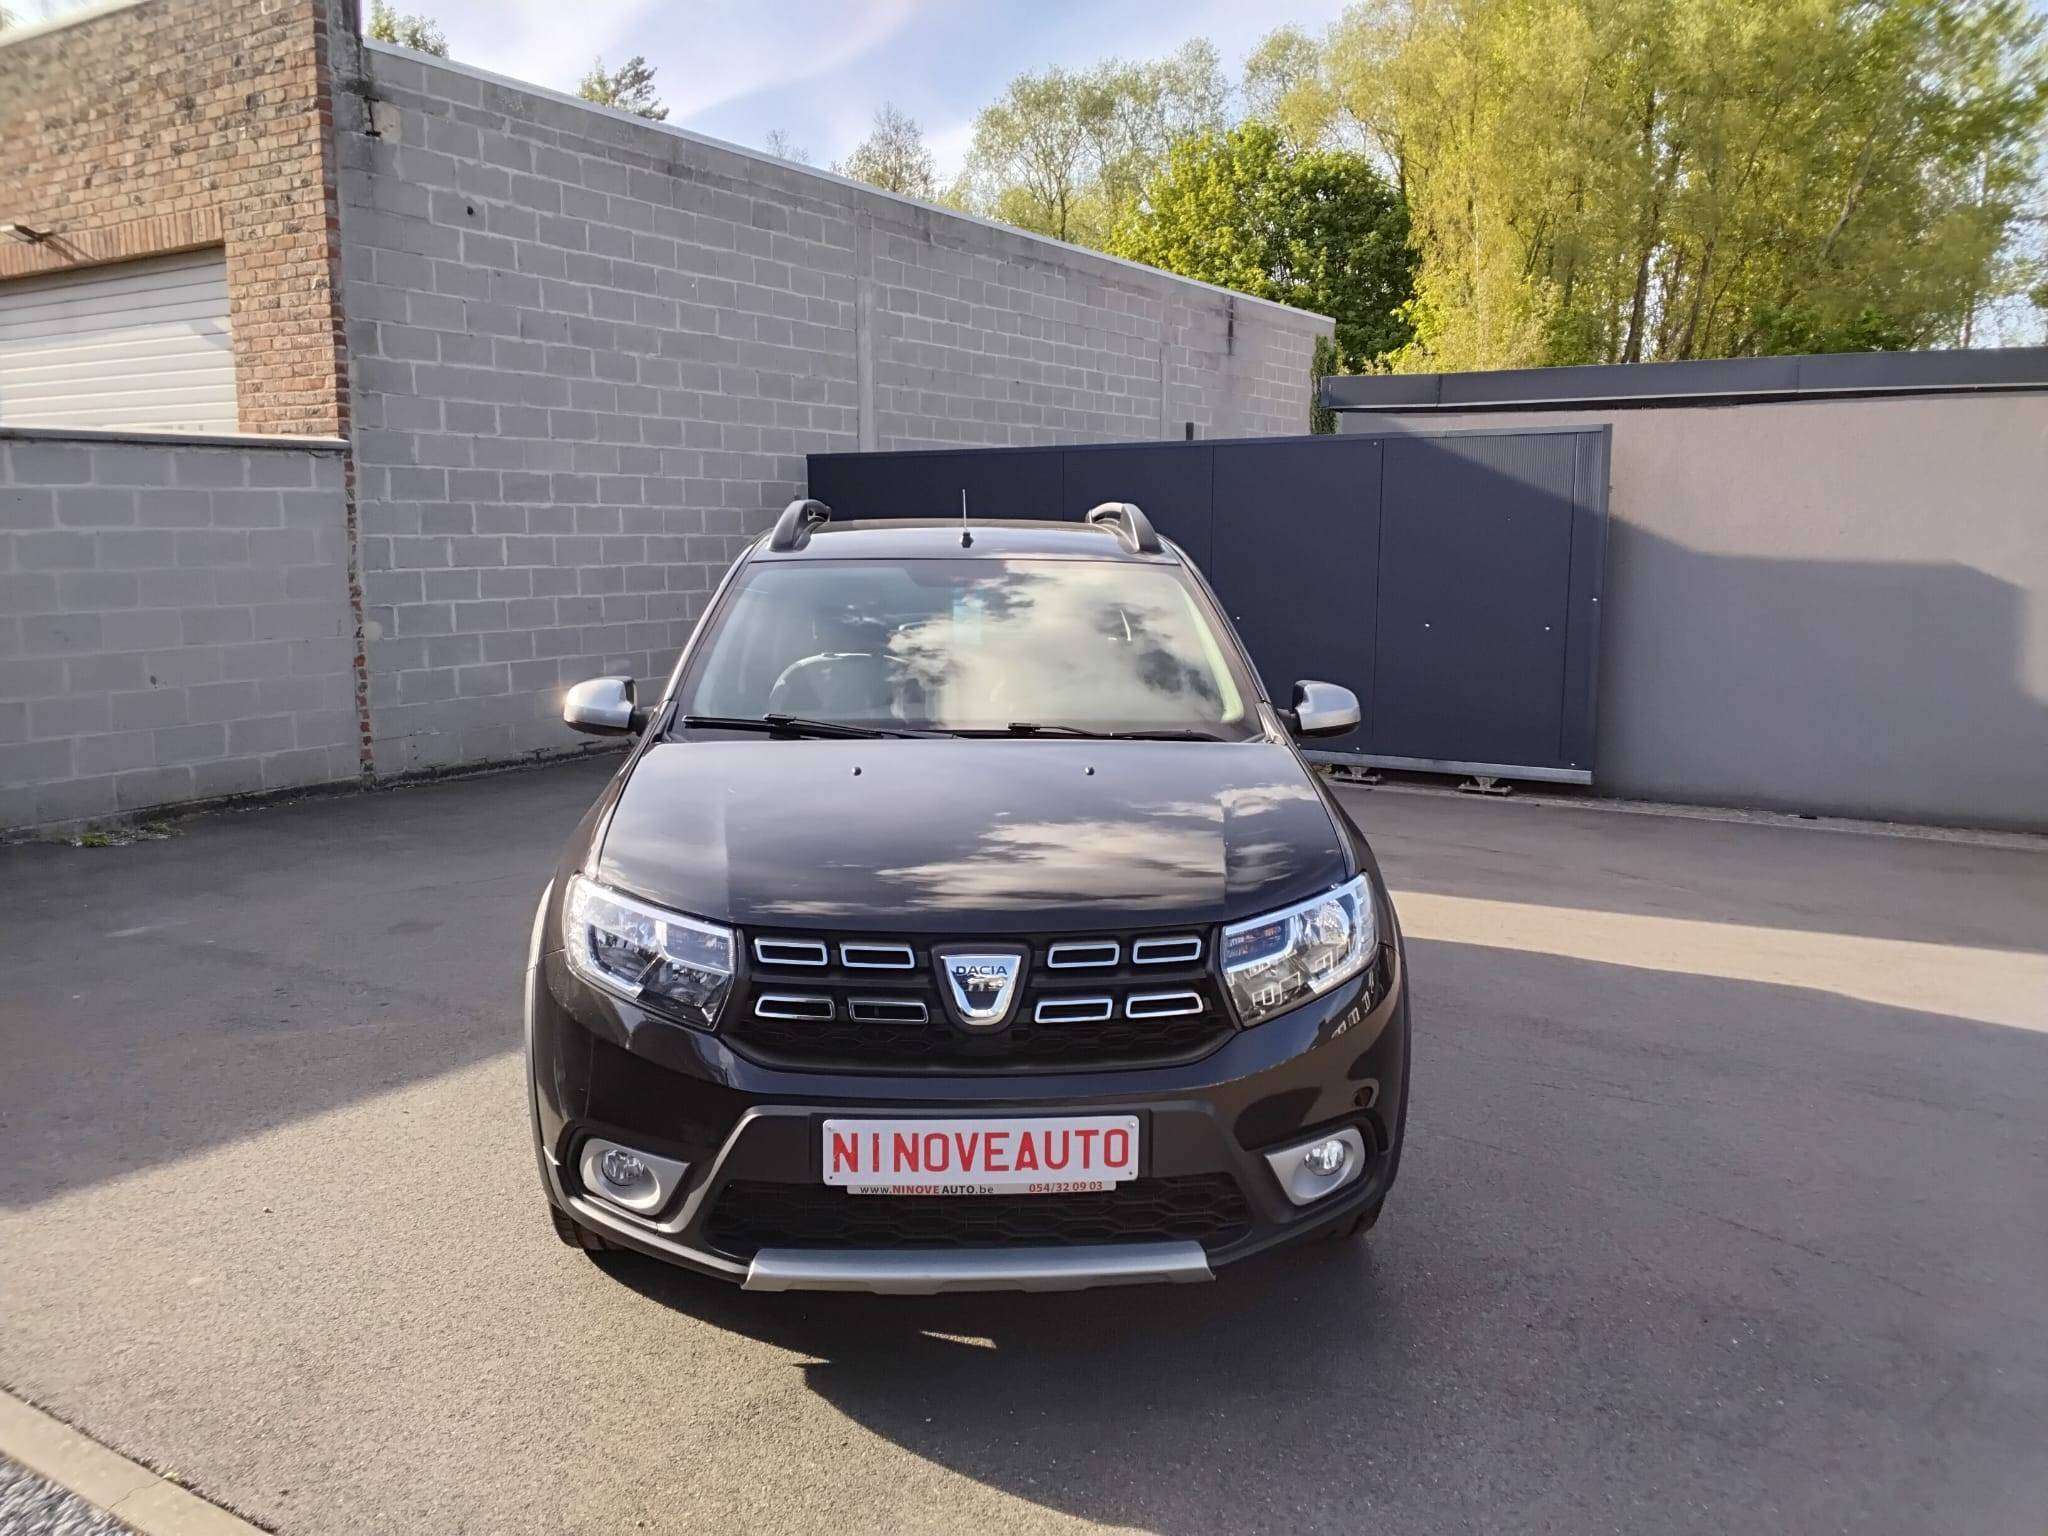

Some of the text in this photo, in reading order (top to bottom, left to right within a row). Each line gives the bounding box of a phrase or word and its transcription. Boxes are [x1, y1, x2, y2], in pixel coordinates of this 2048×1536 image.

[955, 965, 1008, 976] DACIA
[832, 1128, 1129, 1174] NINOVEAUTO
[860, 1181, 1103, 1195] www.NINOVEAUTO.be 054/32 09 03
